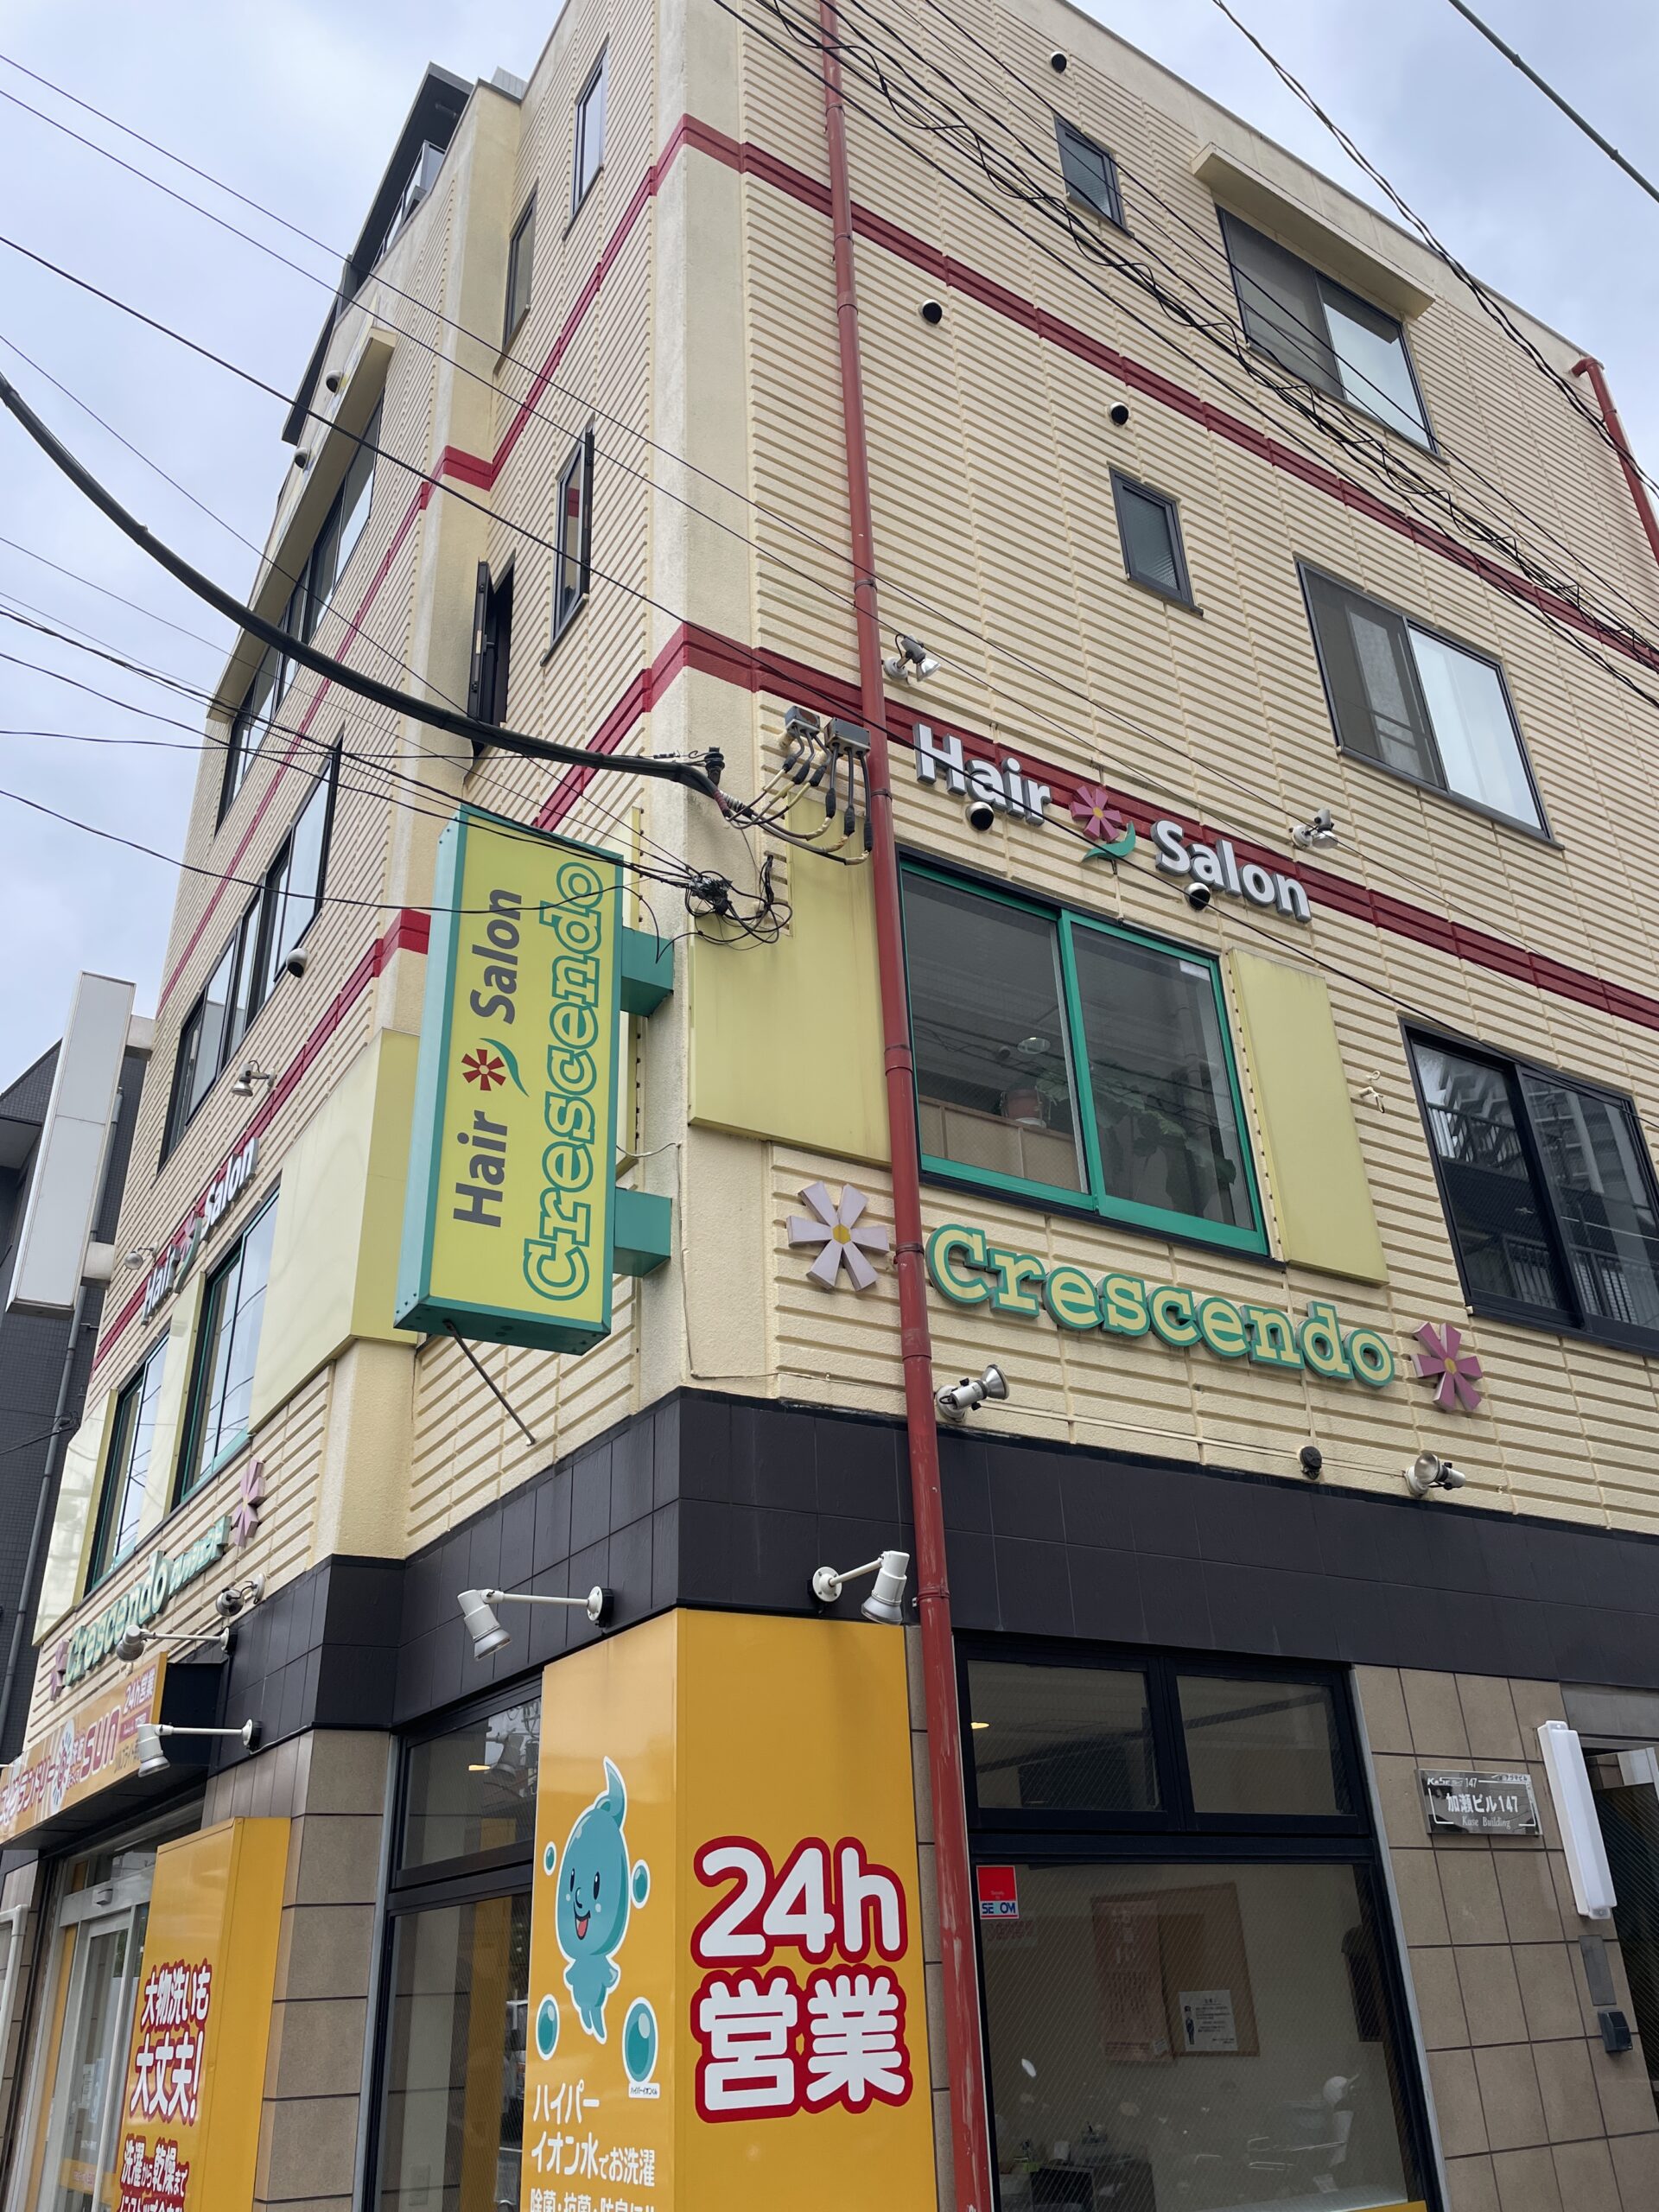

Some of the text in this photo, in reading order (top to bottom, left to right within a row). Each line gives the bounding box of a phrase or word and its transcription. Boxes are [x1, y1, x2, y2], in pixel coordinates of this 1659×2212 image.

[912, 721, 1313, 924] Hair Salon
[453, 888, 522, 1227] Hair Salon
[523, 861, 604, 1301] Crescendo
[142, 1136, 258, 1325] Hair Salon
[926, 1223, 1396, 1387] Crescendo
[65, 1549, 174, 1686] Crescendo
[123, 1664, 156, 1715] 24h営業
[1446, 1792, 1519, 1813] 加瀬ビル147
[1462, 1815, 1511, 1829] Kase Building
[698, 1845, 902, 1959] 24h
[140, 1963, 212, 2027] 大物洗いも
[697, 1973, 907, 2113] 営業
[532, 2078, 601, 2126] ハイパー
[121, 2139, 189, 2197] 洗濯から乾燥まで
[531, 2131, 656, 2188] イオン水でお洗濯
